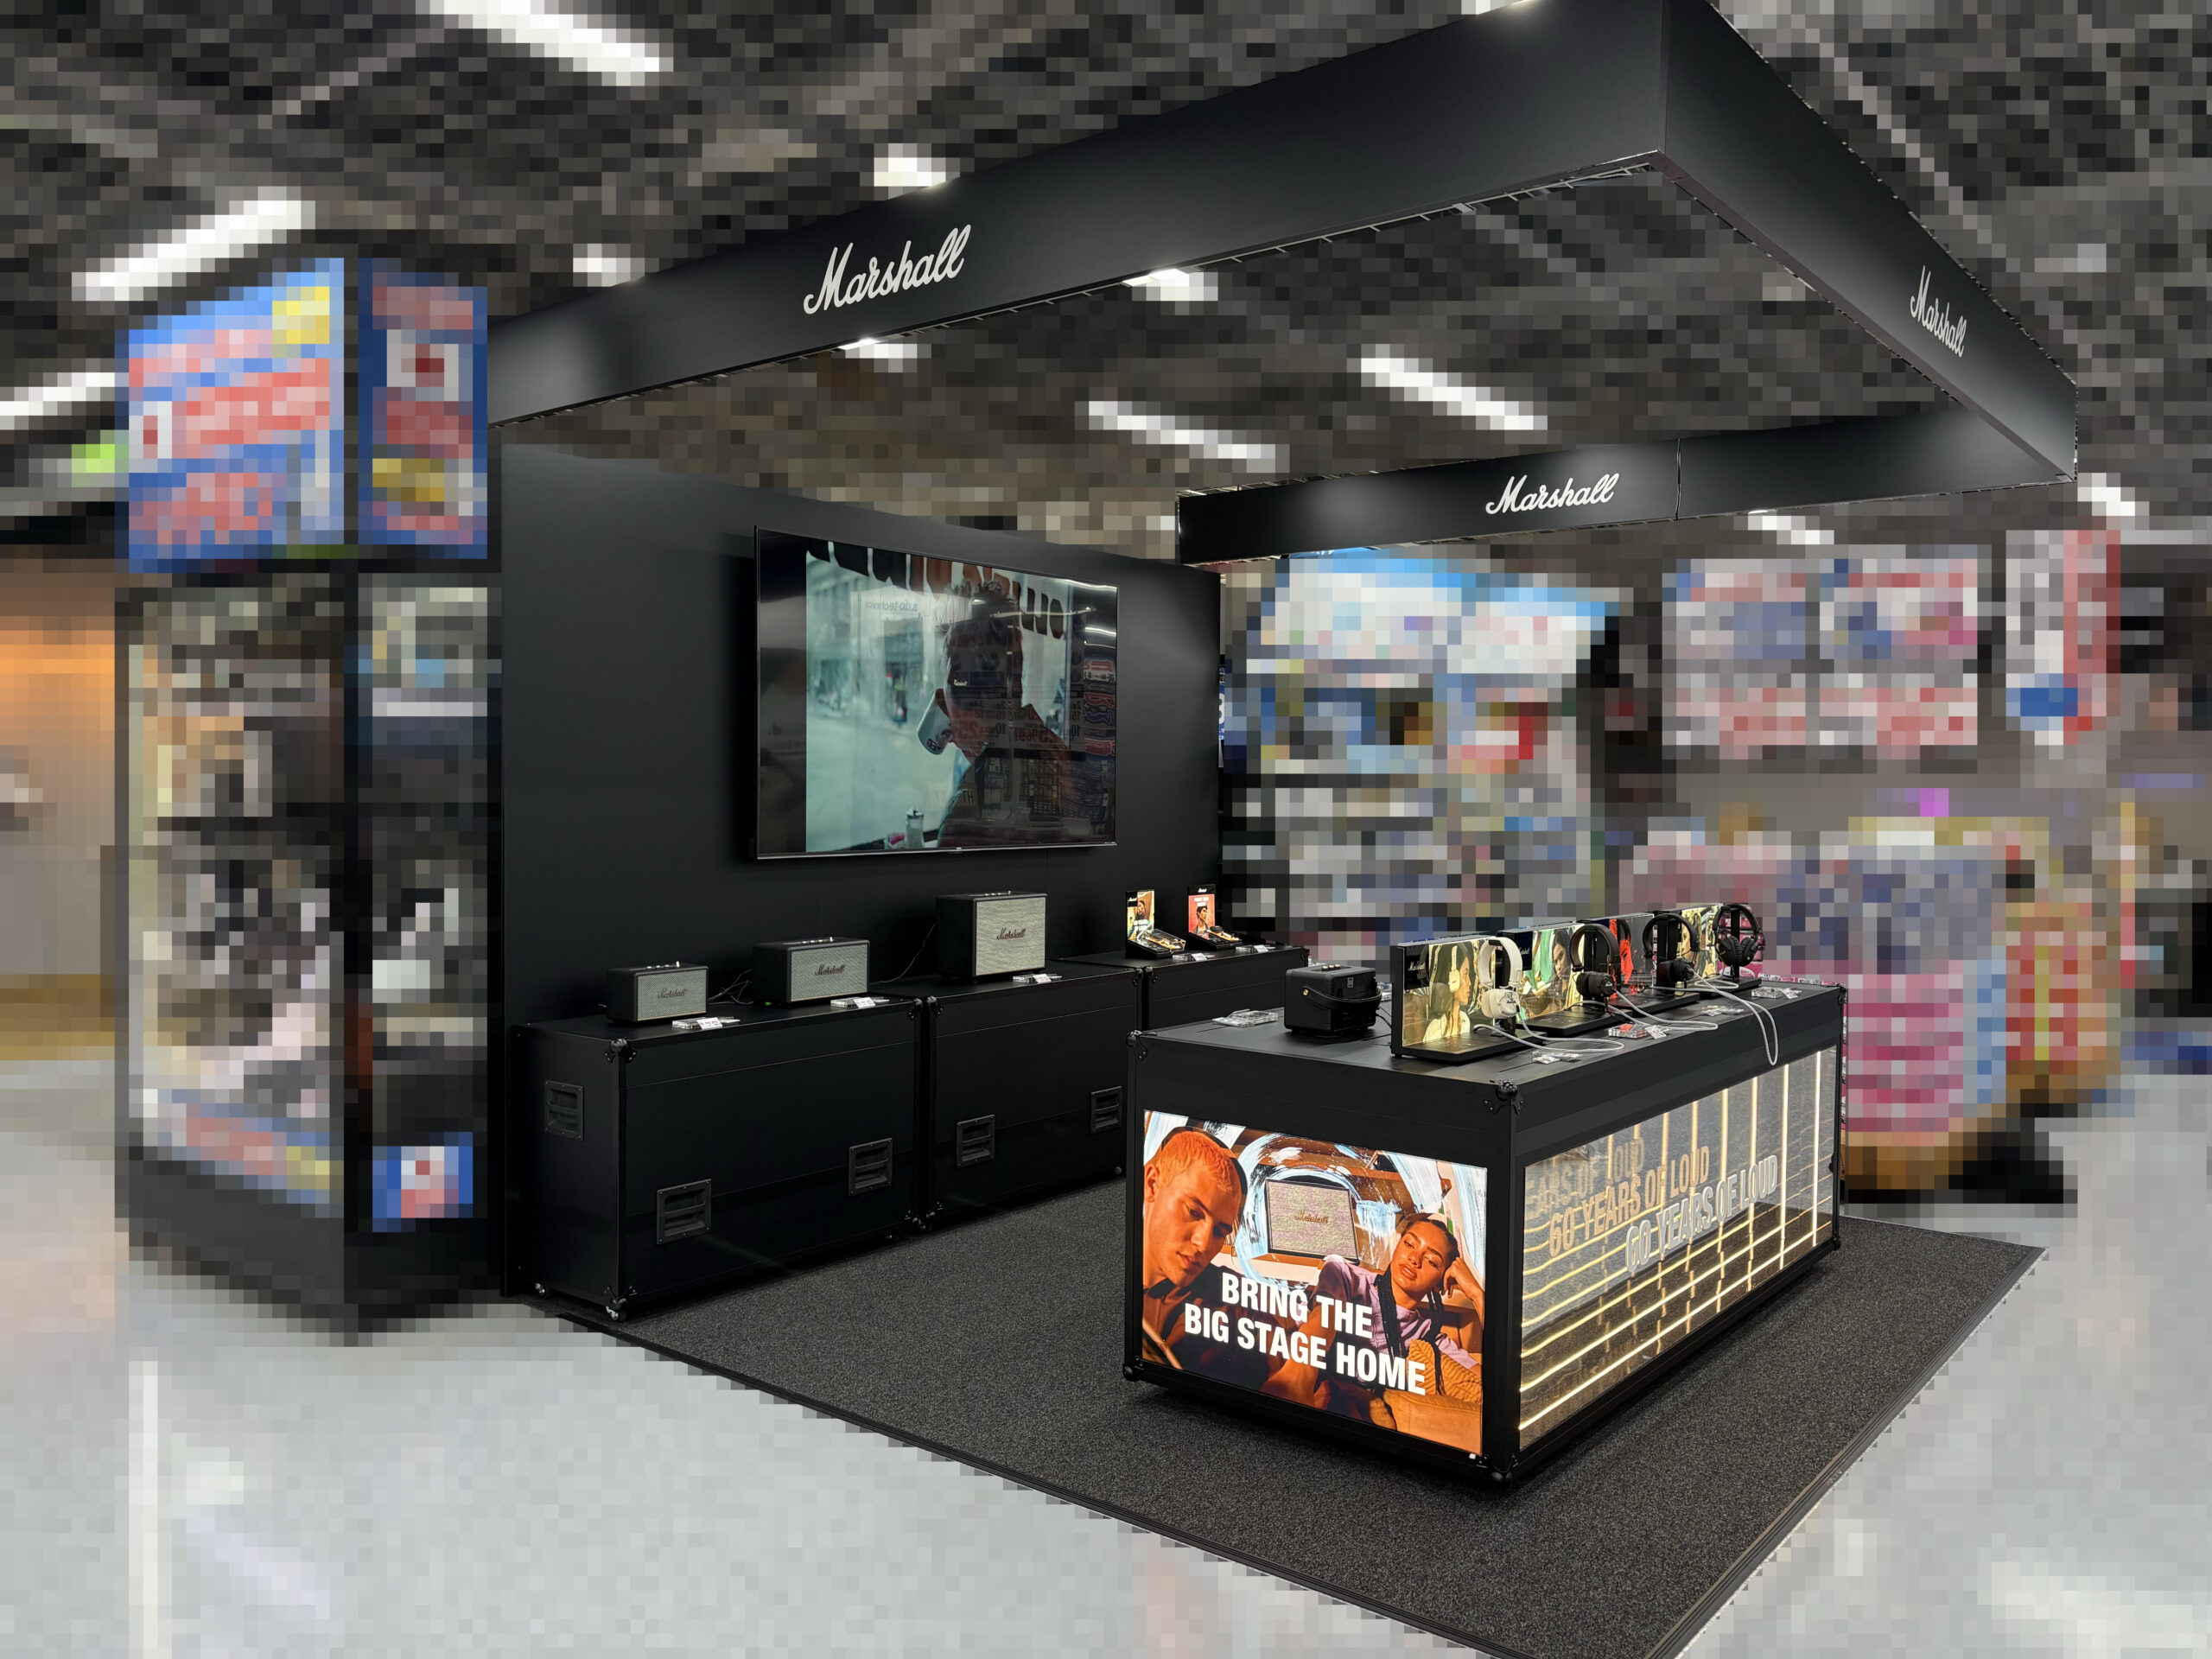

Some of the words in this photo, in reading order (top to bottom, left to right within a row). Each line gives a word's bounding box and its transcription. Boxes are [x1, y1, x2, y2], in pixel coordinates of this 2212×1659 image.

[803, 224, 972, 315] Marshall
[1910, 264, 1967, 358] Marshall
[1485, 473, 1620, 515] Marshall
[1548, 1206, 1575, 1257] 60
[1581, 1174, 1642, 1241] YEARS
[1644, 1164, 1668, 1210] OF
[1669, 1145, 1710, 1198] LOUD
[1625, 1219, 1652, 1273] 60
[1656, 1185, 1714, 1254] YEARS
[1715, 1173, 1738, 1224] OF
[1739, 1154, 1778, 1211] LOUD
[1185, 1302, 1230, 1344] BIG
[1237, 1317, 1327, 1370] STAGE
[1336, 1341, 1427, 1396] HOME
[1222, 1272, 1308, 1323] BRING
[1316, 1294, 1373, 1339] THE
